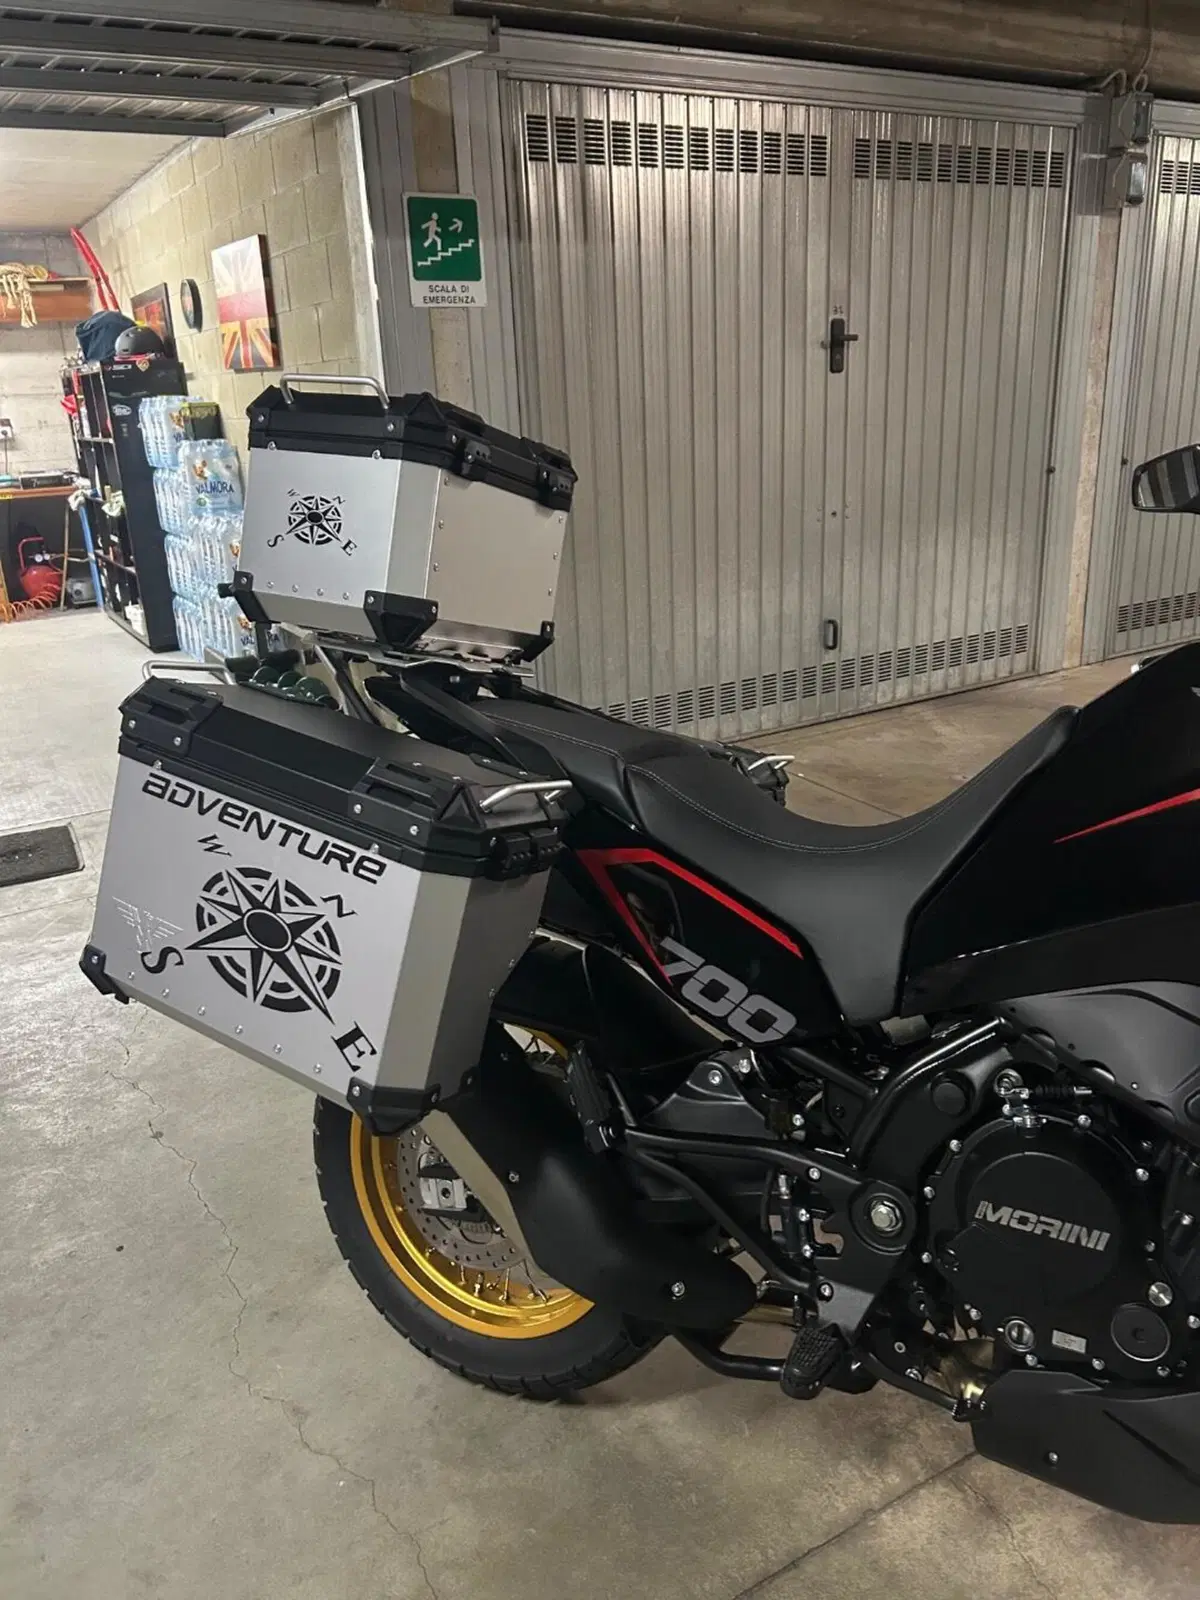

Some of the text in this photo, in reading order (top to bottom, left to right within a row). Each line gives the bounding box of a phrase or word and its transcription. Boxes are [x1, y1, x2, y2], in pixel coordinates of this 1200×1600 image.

[428, 285, 470, 294] SCALA DI
[422, 296, 476, 305] EMERGENZA
[195, 481, 235, 494] VALMORA
[267, 534, 285, 548] S
[340, 539, 358, 557] E
[320, 894, 359, 918] N
[140, 946, 185, 974] S
[659, 936, 798, 1043] 700
[331, 1020, 378, 1073] E
[974, 1200, 1112, 1251] MORINI
